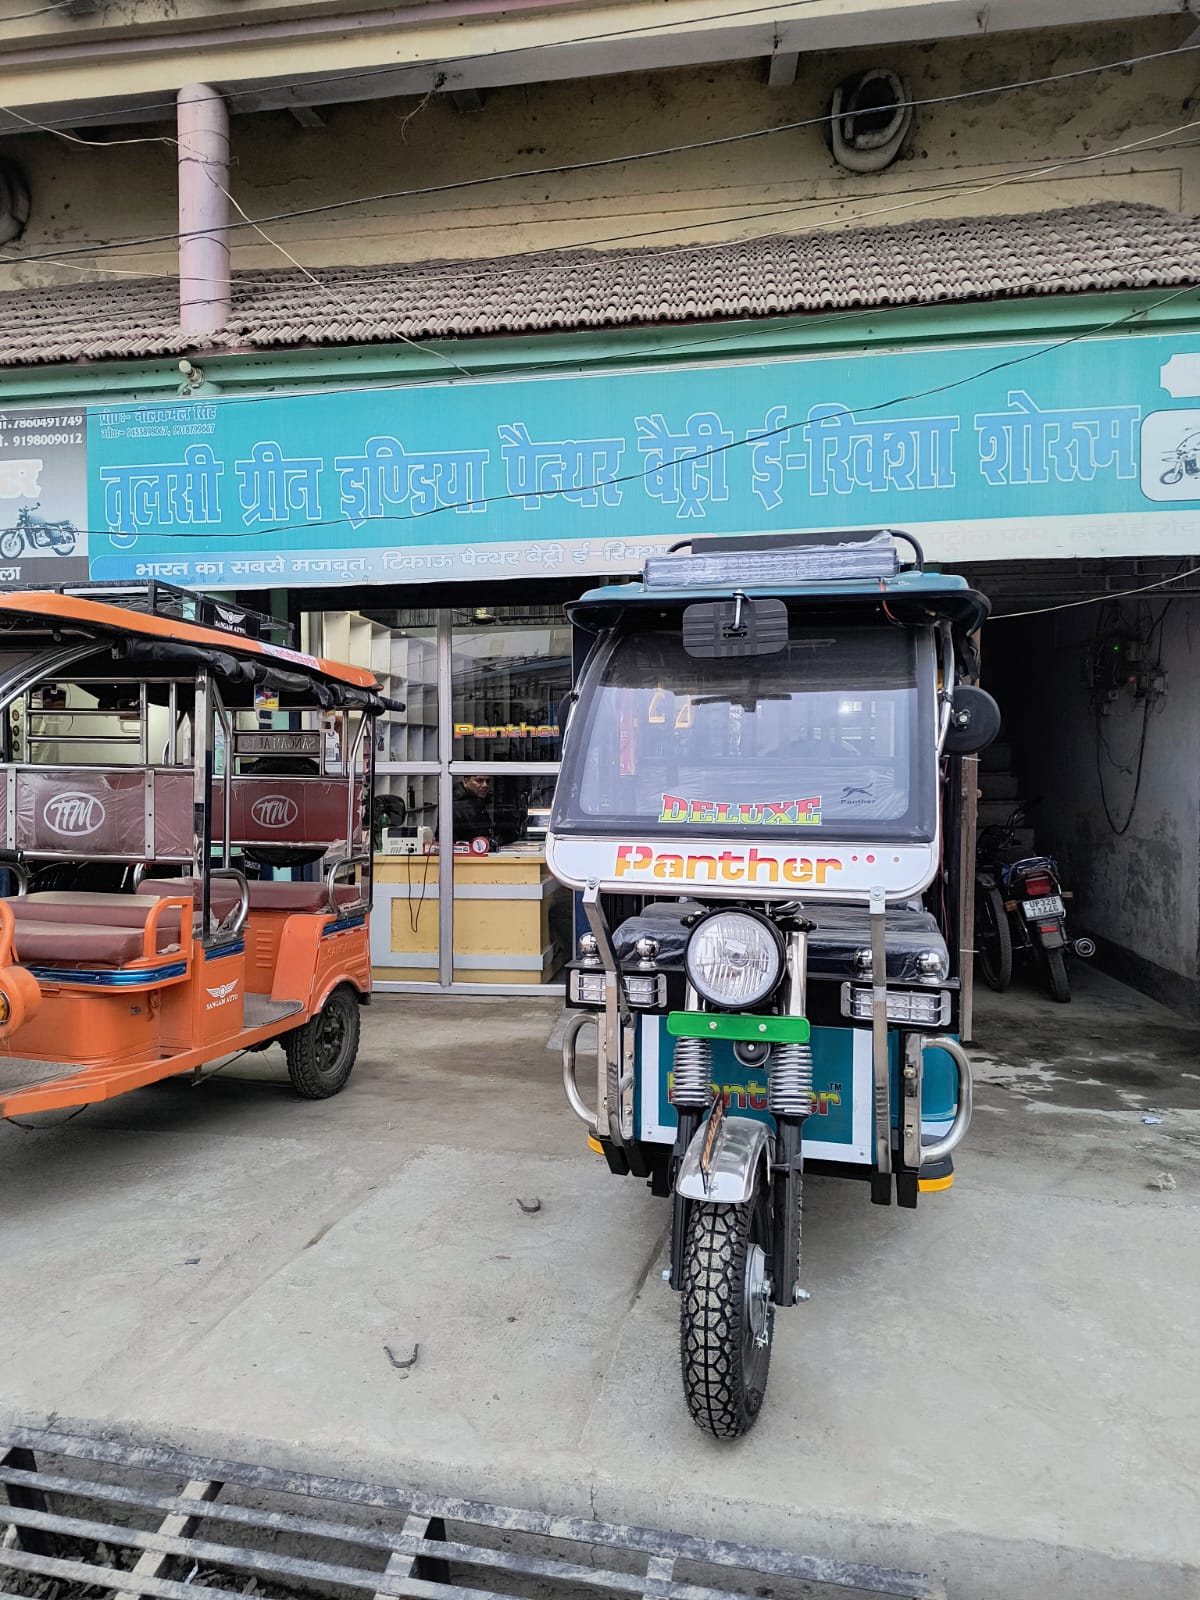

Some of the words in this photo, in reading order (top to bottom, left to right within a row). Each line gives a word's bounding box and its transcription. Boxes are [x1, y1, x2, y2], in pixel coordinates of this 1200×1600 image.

[13, 432, 83, 447] 9198009012
[100, 444, 224, 549] तुलसी
[235, 441, 323, 525] ग्रीन
[334, 436, 489, 529] इण्डिया
[974, 390, 1141, 486] शोरूम
[135, 561, 188, 576] भारत
[195, 560, 225, 576] का
[230, 555, 286, 574] सबसे
[381, 550, 454, 570] टिकाऊ
[659, 793, 822, 826] DELUXE
[614, 845, 843, 884] Panther
